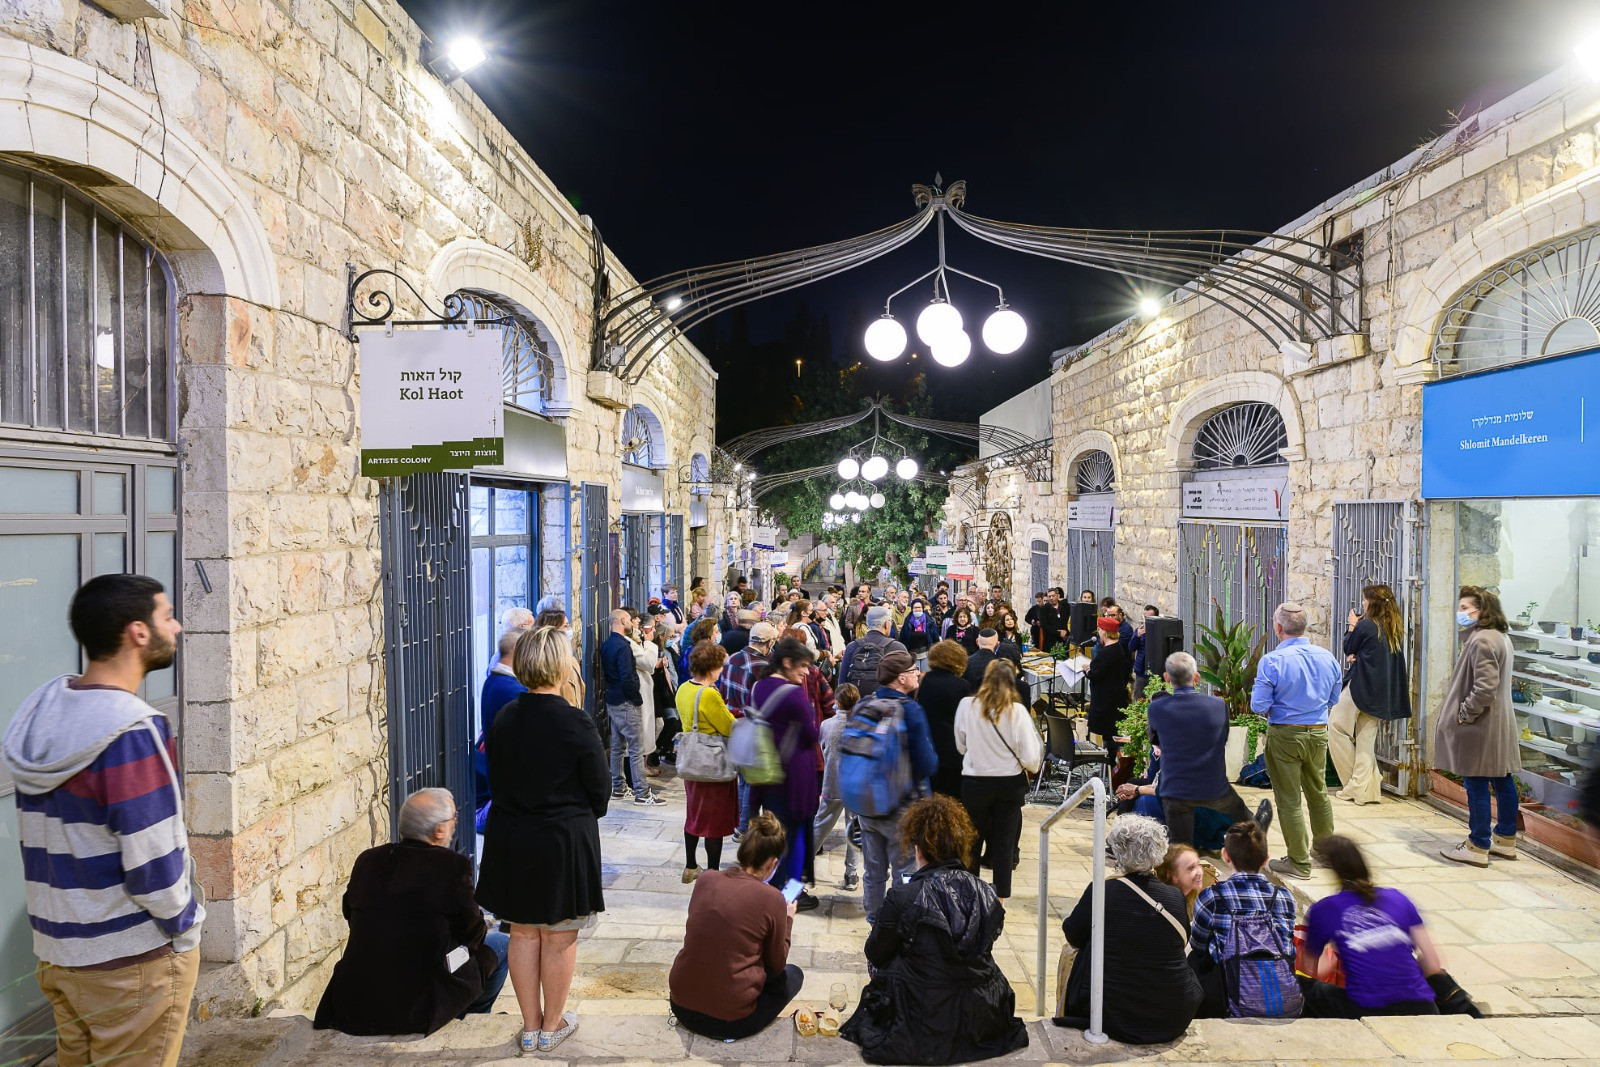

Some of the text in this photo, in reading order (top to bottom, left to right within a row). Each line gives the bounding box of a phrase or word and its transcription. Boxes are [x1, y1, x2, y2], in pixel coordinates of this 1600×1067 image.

[400, 368, 462, 383] קול האות
[400, 387, 464, 400] Kol Haot
[1471, 410, 1534, 428] שלומית מנדלקרן
[1459, 433, 1548, 450] Shlomit Mandelkeren
[400, 456, 432, 464] COLONY
[474, 449, 497, 457] חוצות
